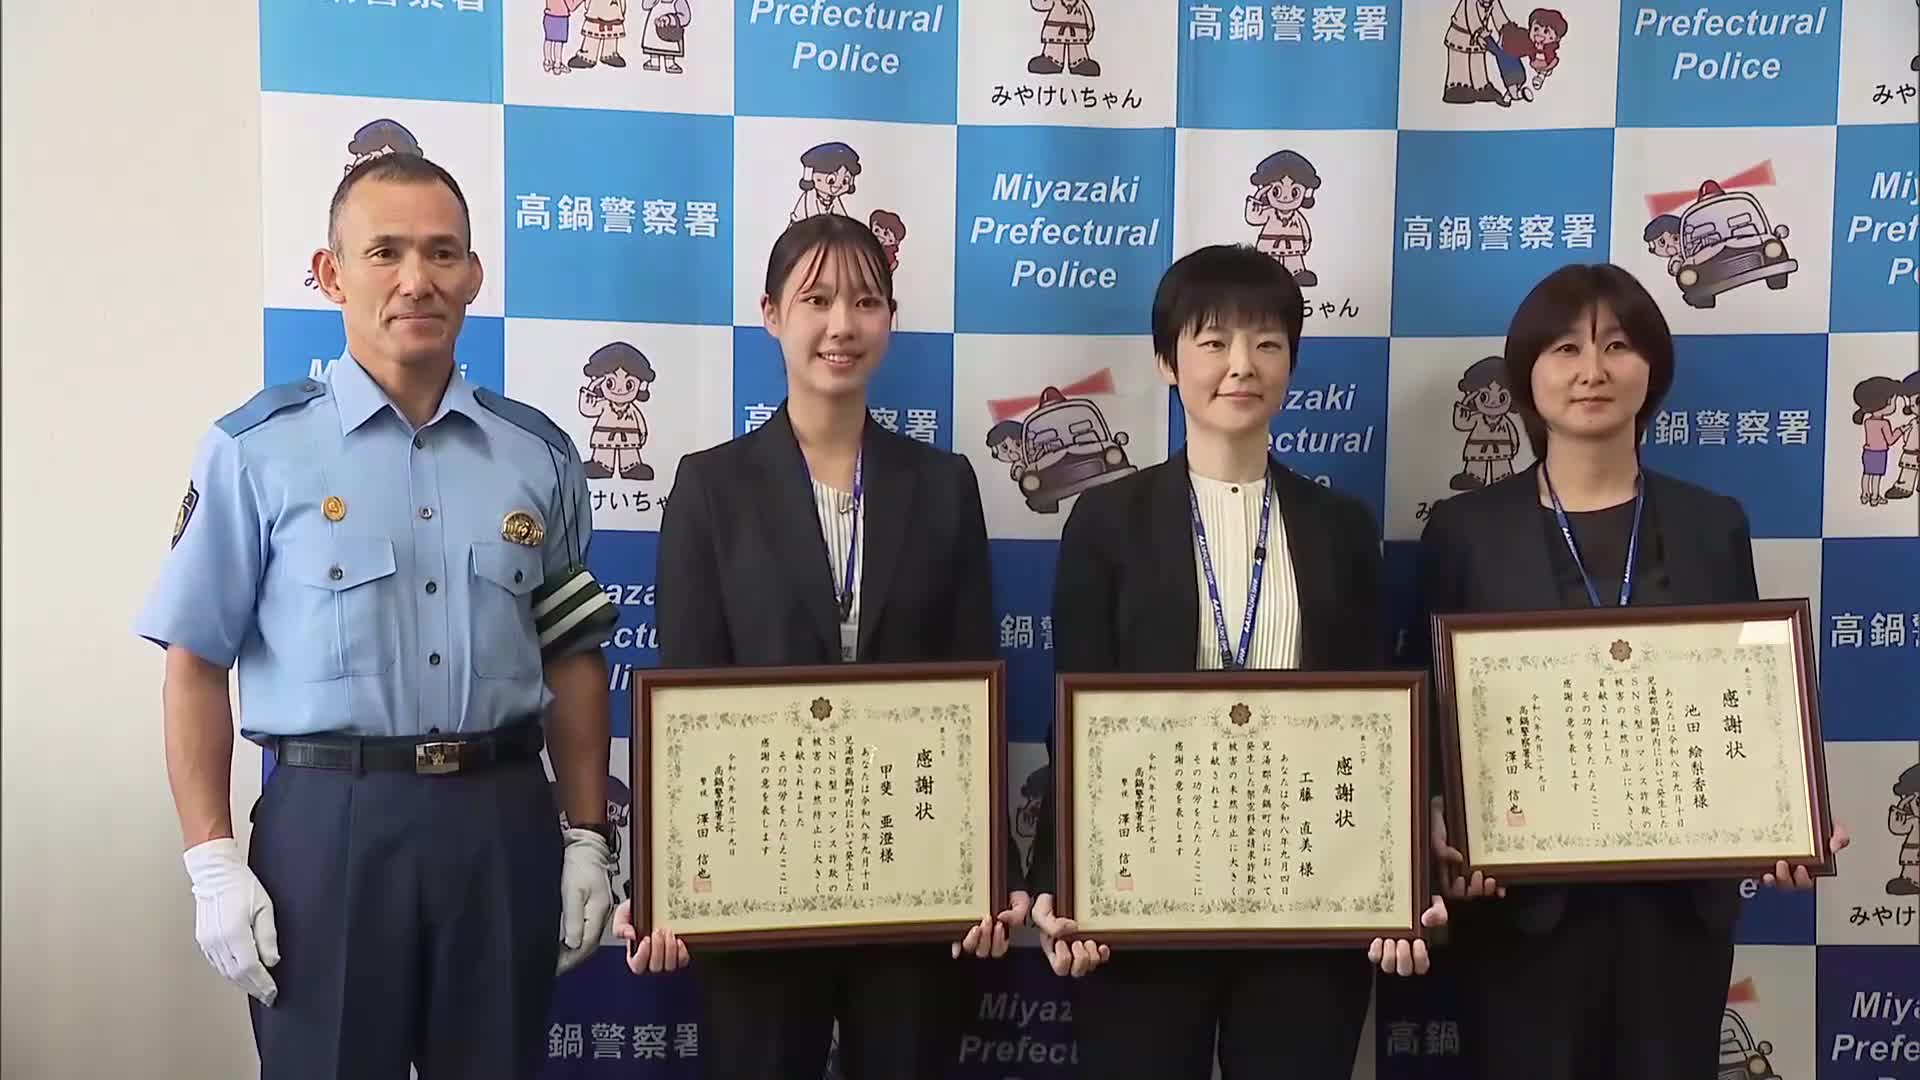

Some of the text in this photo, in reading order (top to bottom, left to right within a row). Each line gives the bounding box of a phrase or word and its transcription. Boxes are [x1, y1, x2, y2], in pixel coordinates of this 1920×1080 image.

[750, 0, 943, 33] Prefectural
[1189, 4, 1389, 42] 高鍋警察署
[1634, 6, 1828, 37] Prefectural
[792, 41, 901, 75] Police
[1672, 51, 1781, 81] Police
[991, 84, 1143, 110] みやけいちゃん
[992, 173, 1141, 209] Miyazaki
[515, 191, 720, 239] 高鍋警察署
[969, 216, 1159, 247] Prefectural
[1402, 213, 1597, 251] 高鍋警察署
[1011, 259, 1118, 289] Police
[1684, 704, 1701, 733] 池田
[1722, 688, 1747, 760] 感謝状
[881, 763, 894, 797] 甲斐
[915, 748, 936, 822] 感謝状
[1299, 771, 1315, 803] 工藤
[1335, 755, 1356, 829] 感謝状
